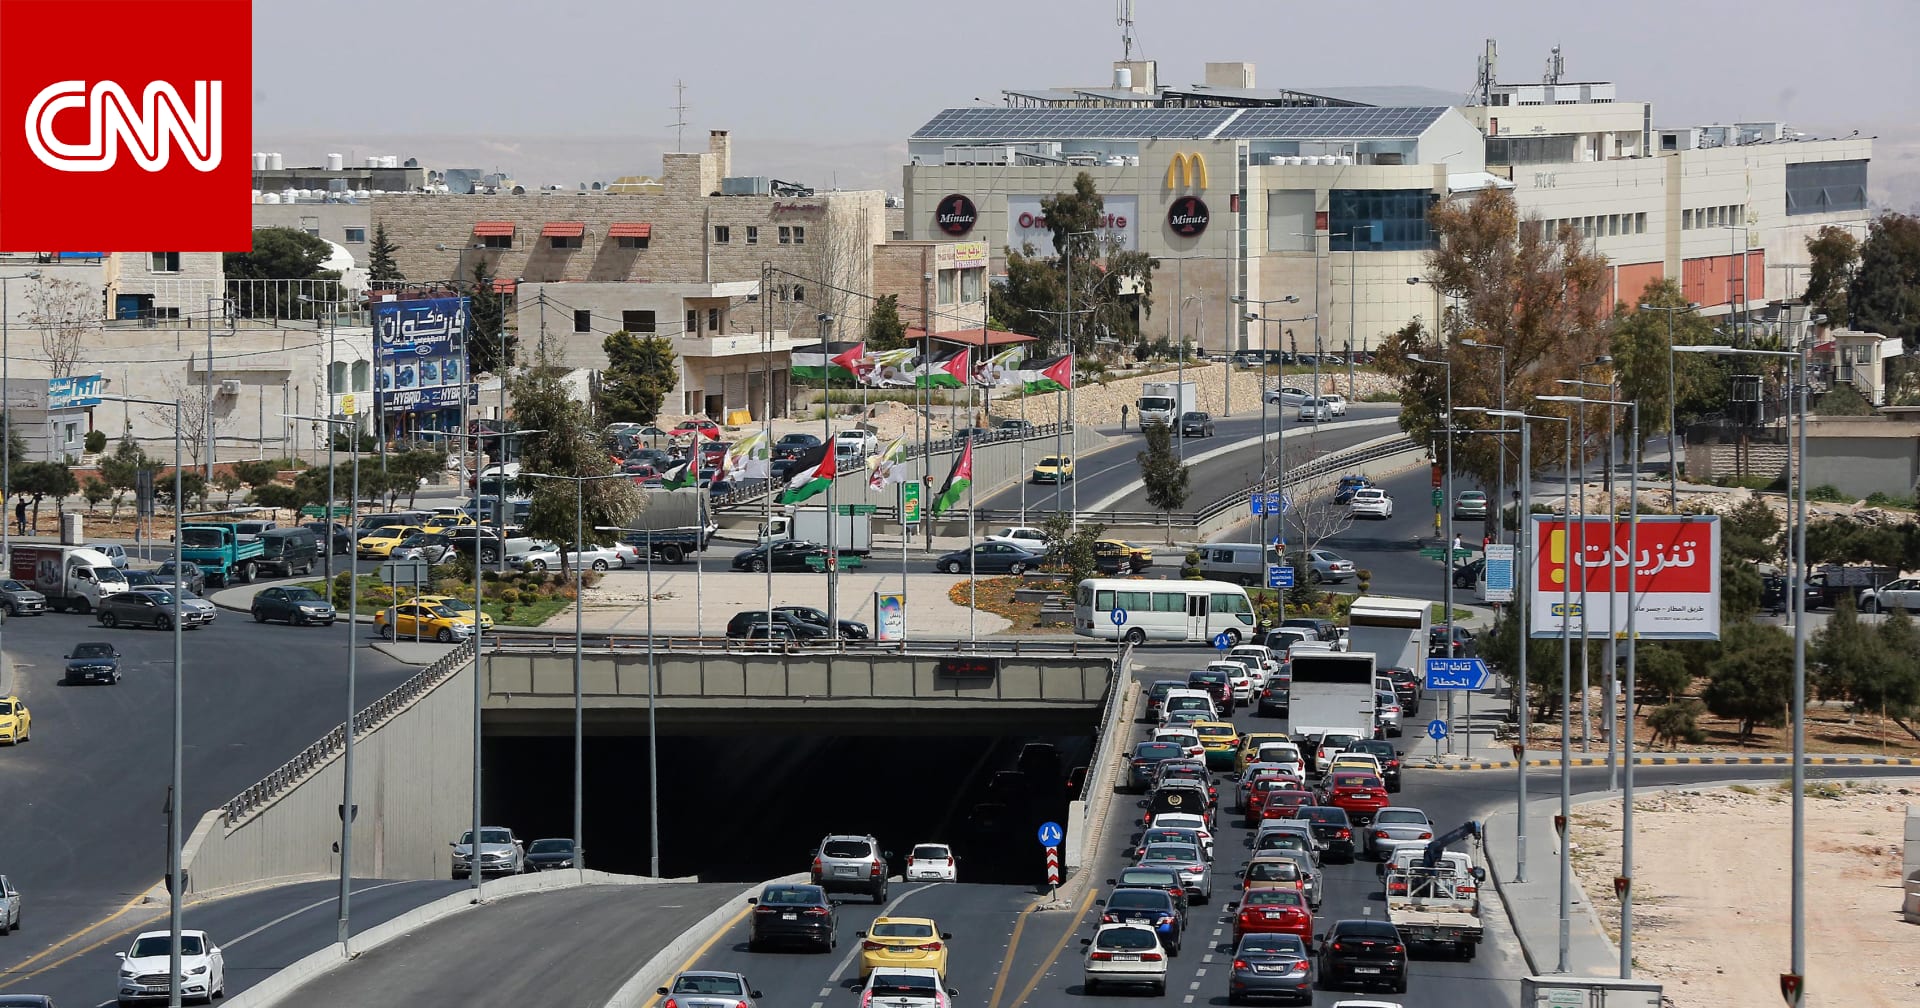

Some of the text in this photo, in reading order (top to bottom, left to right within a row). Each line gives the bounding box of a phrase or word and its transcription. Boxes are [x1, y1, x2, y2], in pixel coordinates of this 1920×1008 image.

[939, 213, 975, 223] Minute
[1171, 214, 1207, 225] Minute
[441, 387, 468, 401] HYBRD
[1431, 661, 1471, 675] تقاطع النشا
[1433, 677, 1469, 686] المحطة
